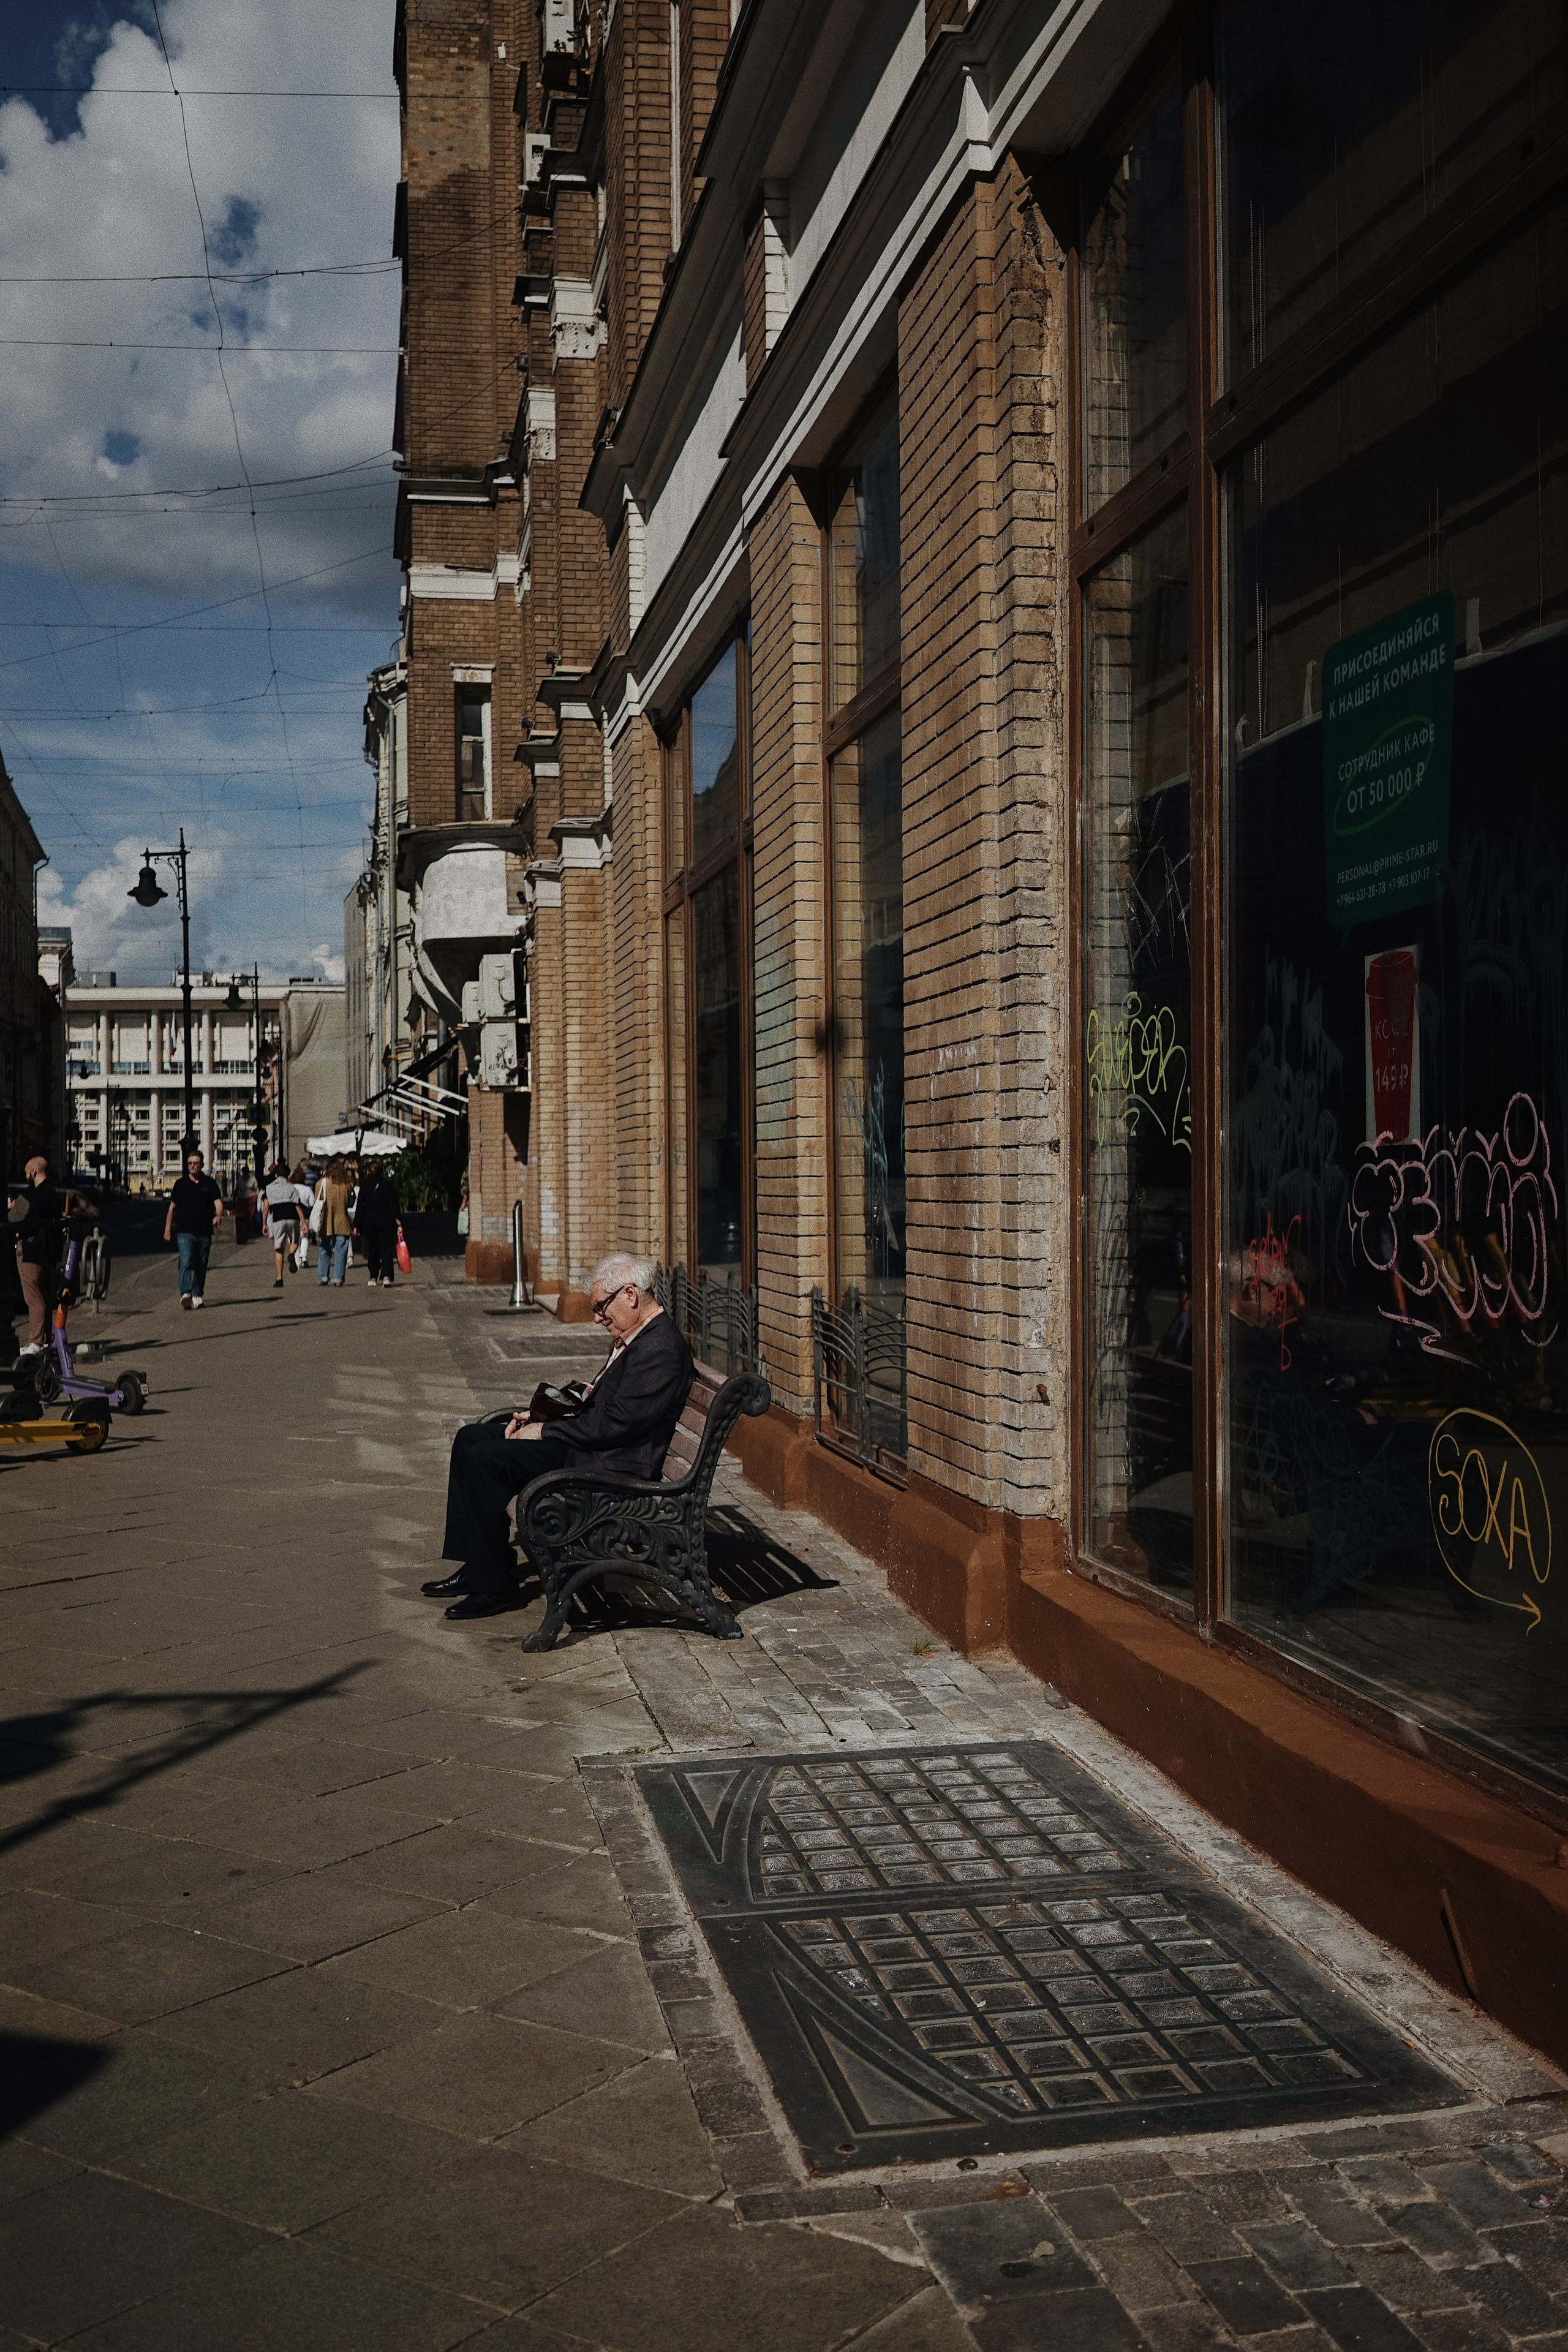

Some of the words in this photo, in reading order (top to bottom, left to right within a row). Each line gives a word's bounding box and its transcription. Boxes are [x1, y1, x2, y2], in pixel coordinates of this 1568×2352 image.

[1333, 612, 1439, 687] ПРИСОЕДИНЯЙСЯ
[1329, 699, 1336, 720] К
[1339, 673, 1379, 715] НАШЕЙ
[1383, 643, 1446, 693] КОМАНДЕ
[1338, 738, 1401, 781] СОТРУДНИК
[1404, 723, 1435, 753] КАФЕ
[1348, 786, 1365, 813] ОТ
[1369, 778, 1384, 805] 50
[1387, 767, 1412, 797] 000
[1337, 839, 1439, 884] PERSONAL@PRIME-STAR.RU
